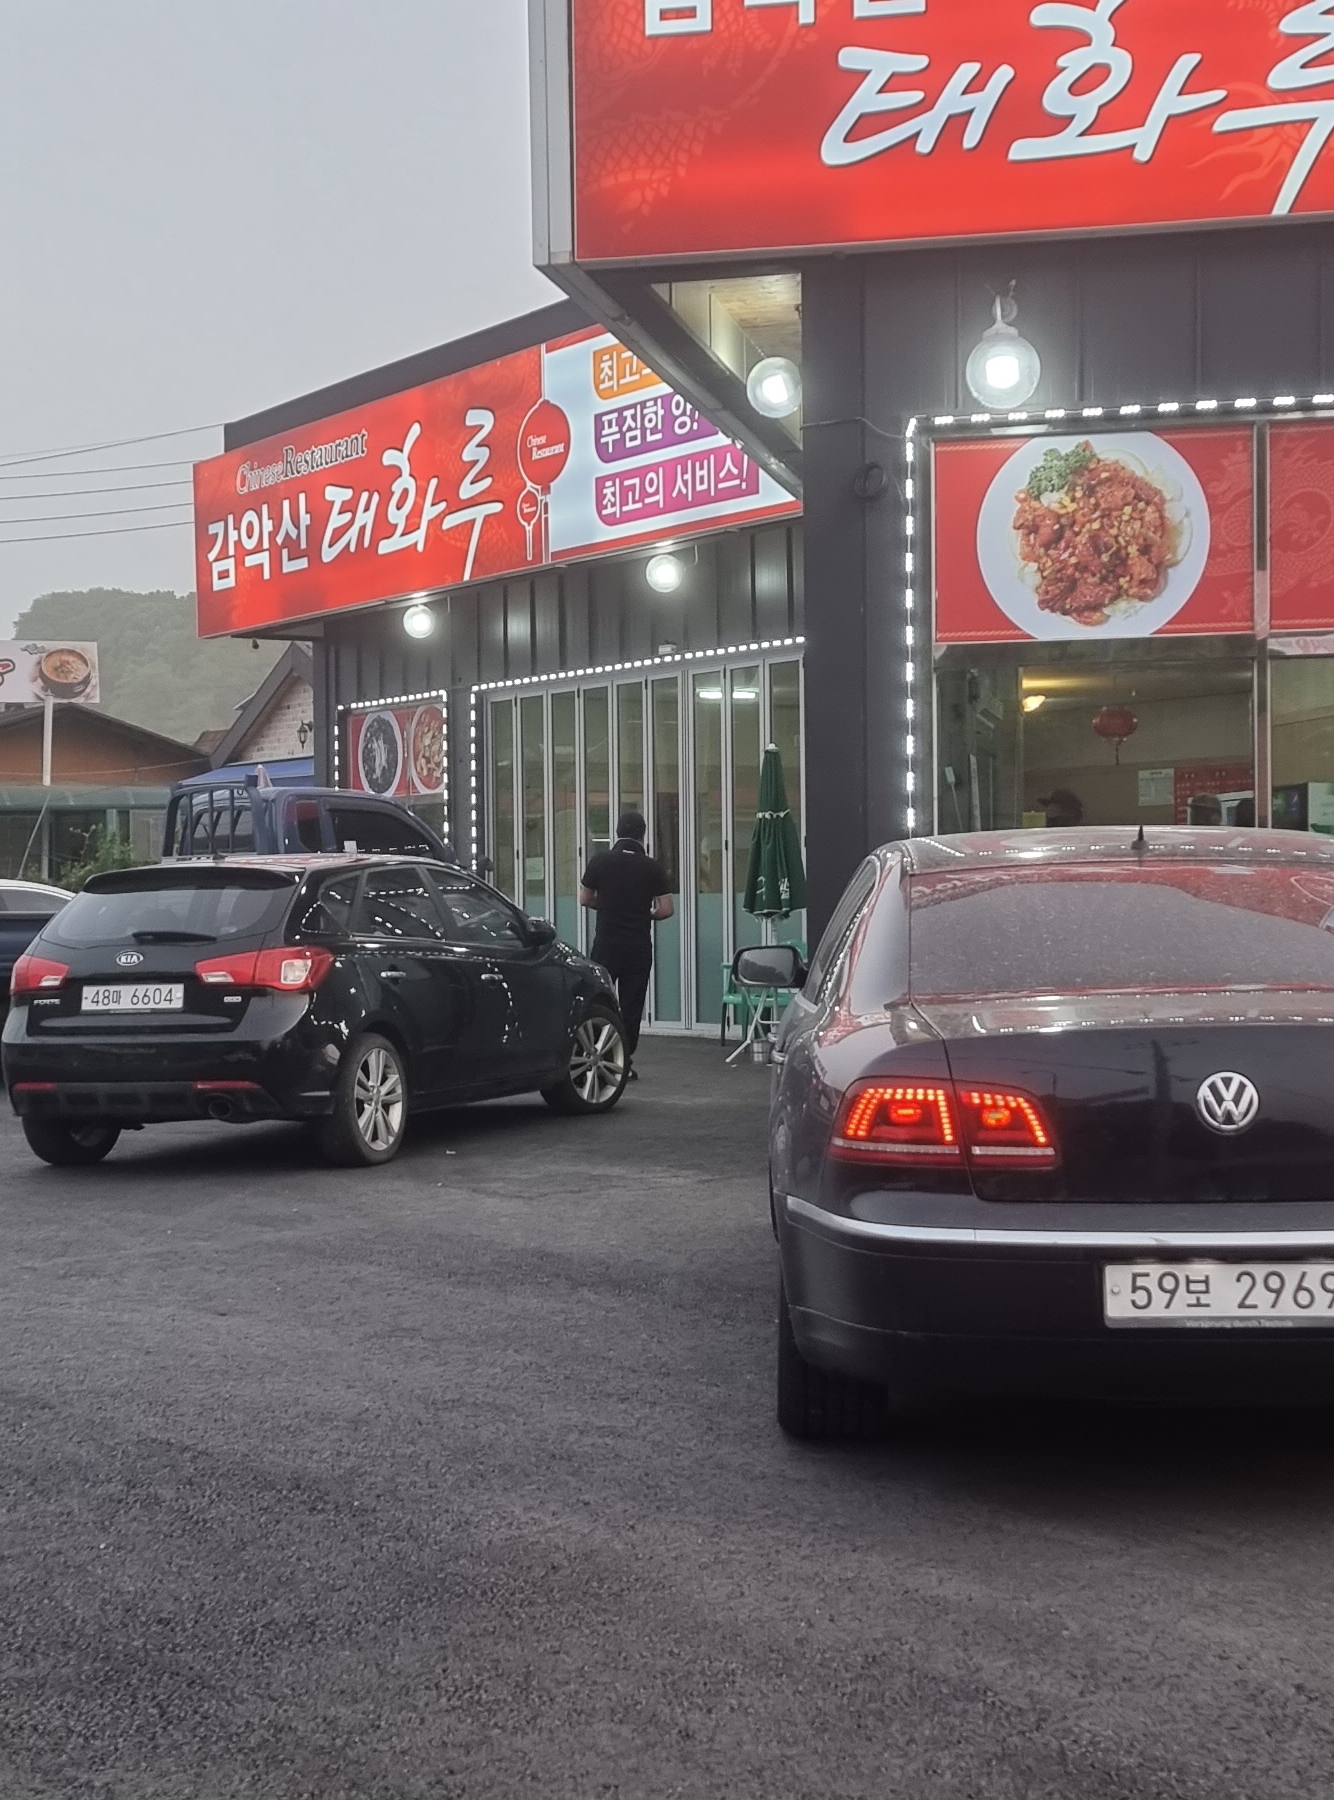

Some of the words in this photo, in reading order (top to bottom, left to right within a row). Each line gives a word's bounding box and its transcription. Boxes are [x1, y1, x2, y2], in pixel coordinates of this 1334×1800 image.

[598, 349, 653, 393] 최고
[600, 397, 665, 454] 푸짐한
[283, 428, 368, 480] Restaurant
[207, 491, 311, 592] 감악산
[321, 408, 504, 581] 태화루
[601, 466, 664, 518] 최고의
[672, 452, 748, 501] 서비스!
[120, 954, 139, 964] KIA
[130, 987, 174, 1006] 6604
[1130, 1271, 1211, 1310] 59보
